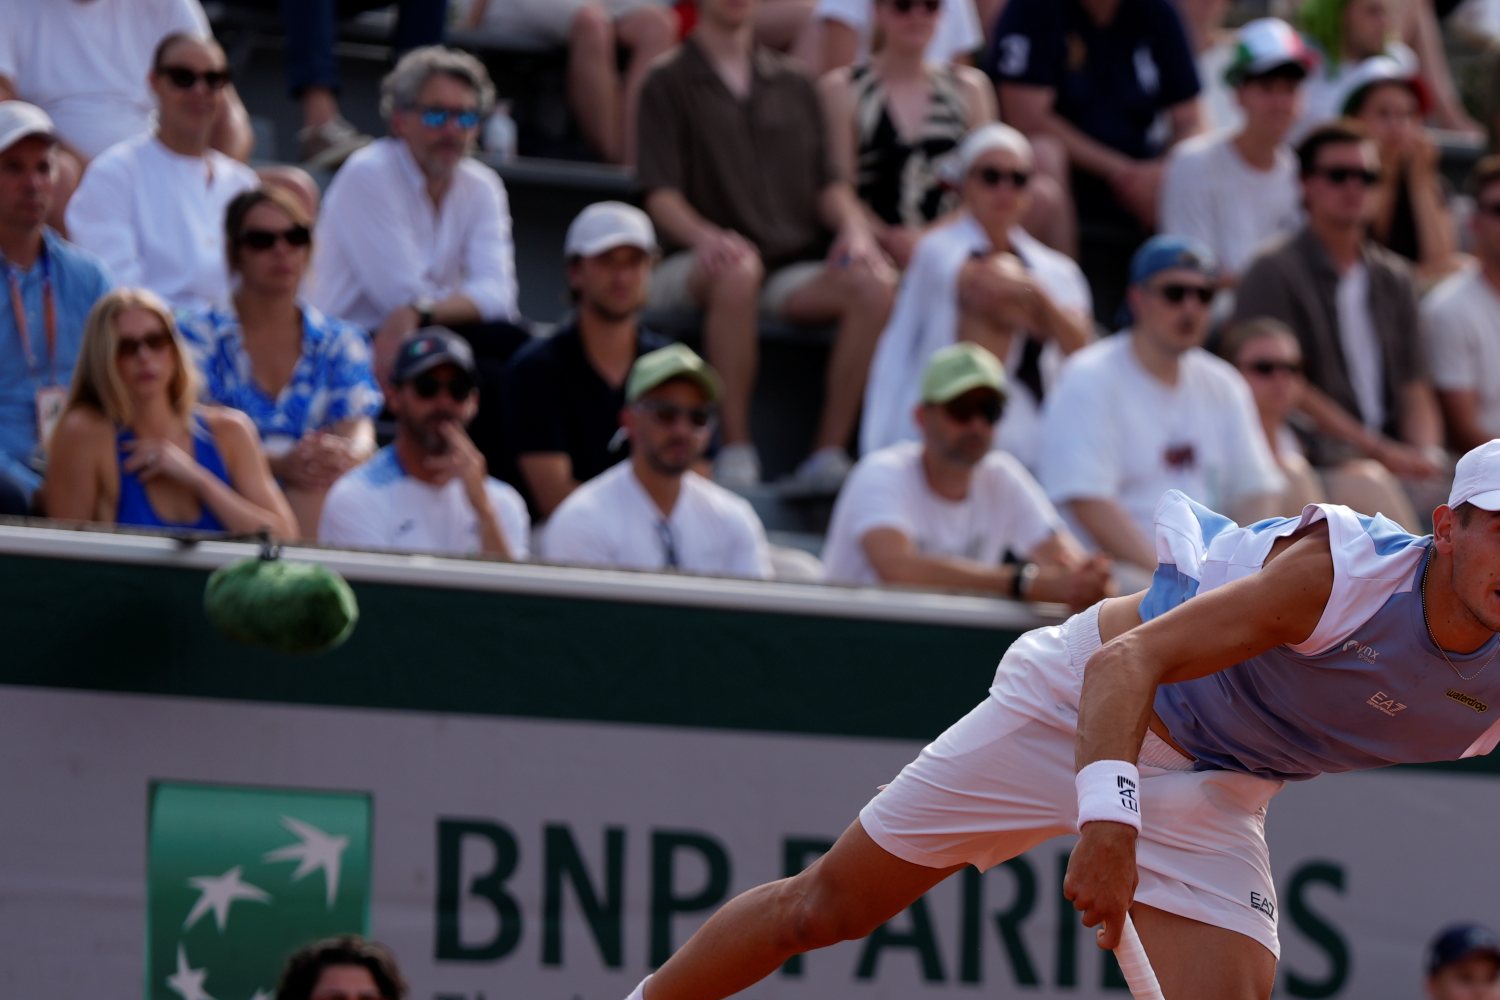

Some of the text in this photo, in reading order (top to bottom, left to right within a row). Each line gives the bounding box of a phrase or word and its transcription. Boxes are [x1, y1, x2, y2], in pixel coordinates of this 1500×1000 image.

[1369, 691, 1408, 713] EA7
[1446, 690, 1488, 712] waterdrop
[1117, 775, 1138, 813] EA7
[434, 815, 733, 972] BNP
[1251, 891, 1275, 917] EA7
